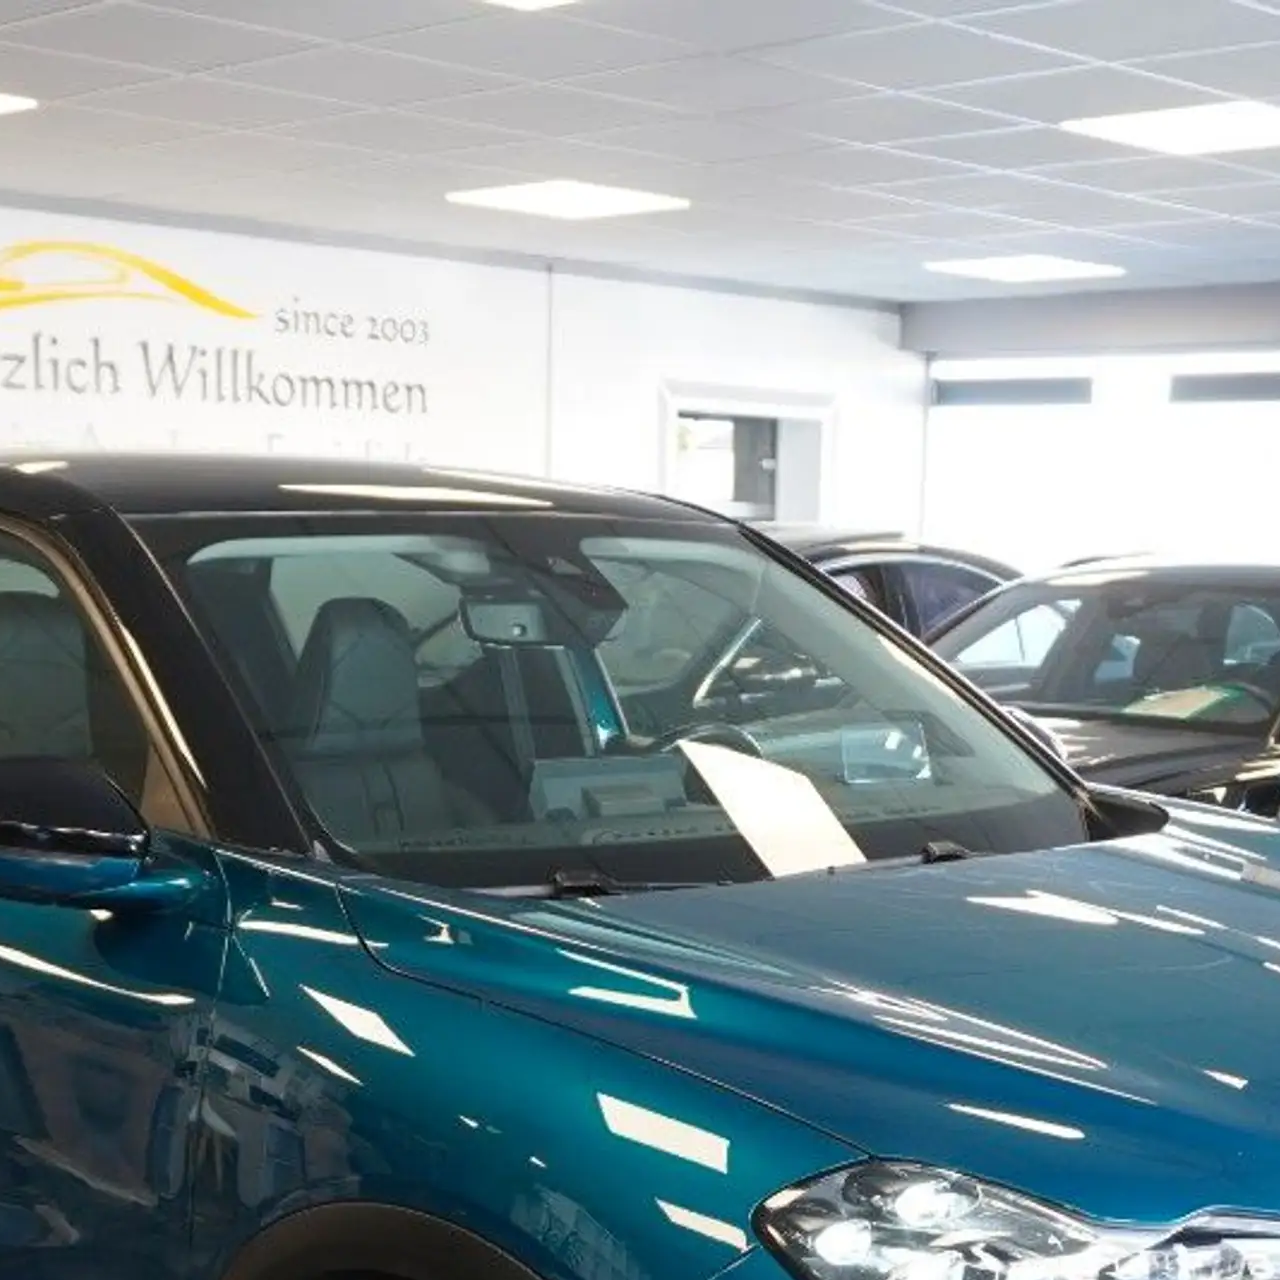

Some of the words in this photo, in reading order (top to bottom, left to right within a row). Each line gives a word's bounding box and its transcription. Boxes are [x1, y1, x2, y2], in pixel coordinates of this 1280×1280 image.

[274, 296, 355, 339] since
[366, 315, 430, 345] 2003
[137, 340, 429, 415] Willkommen
